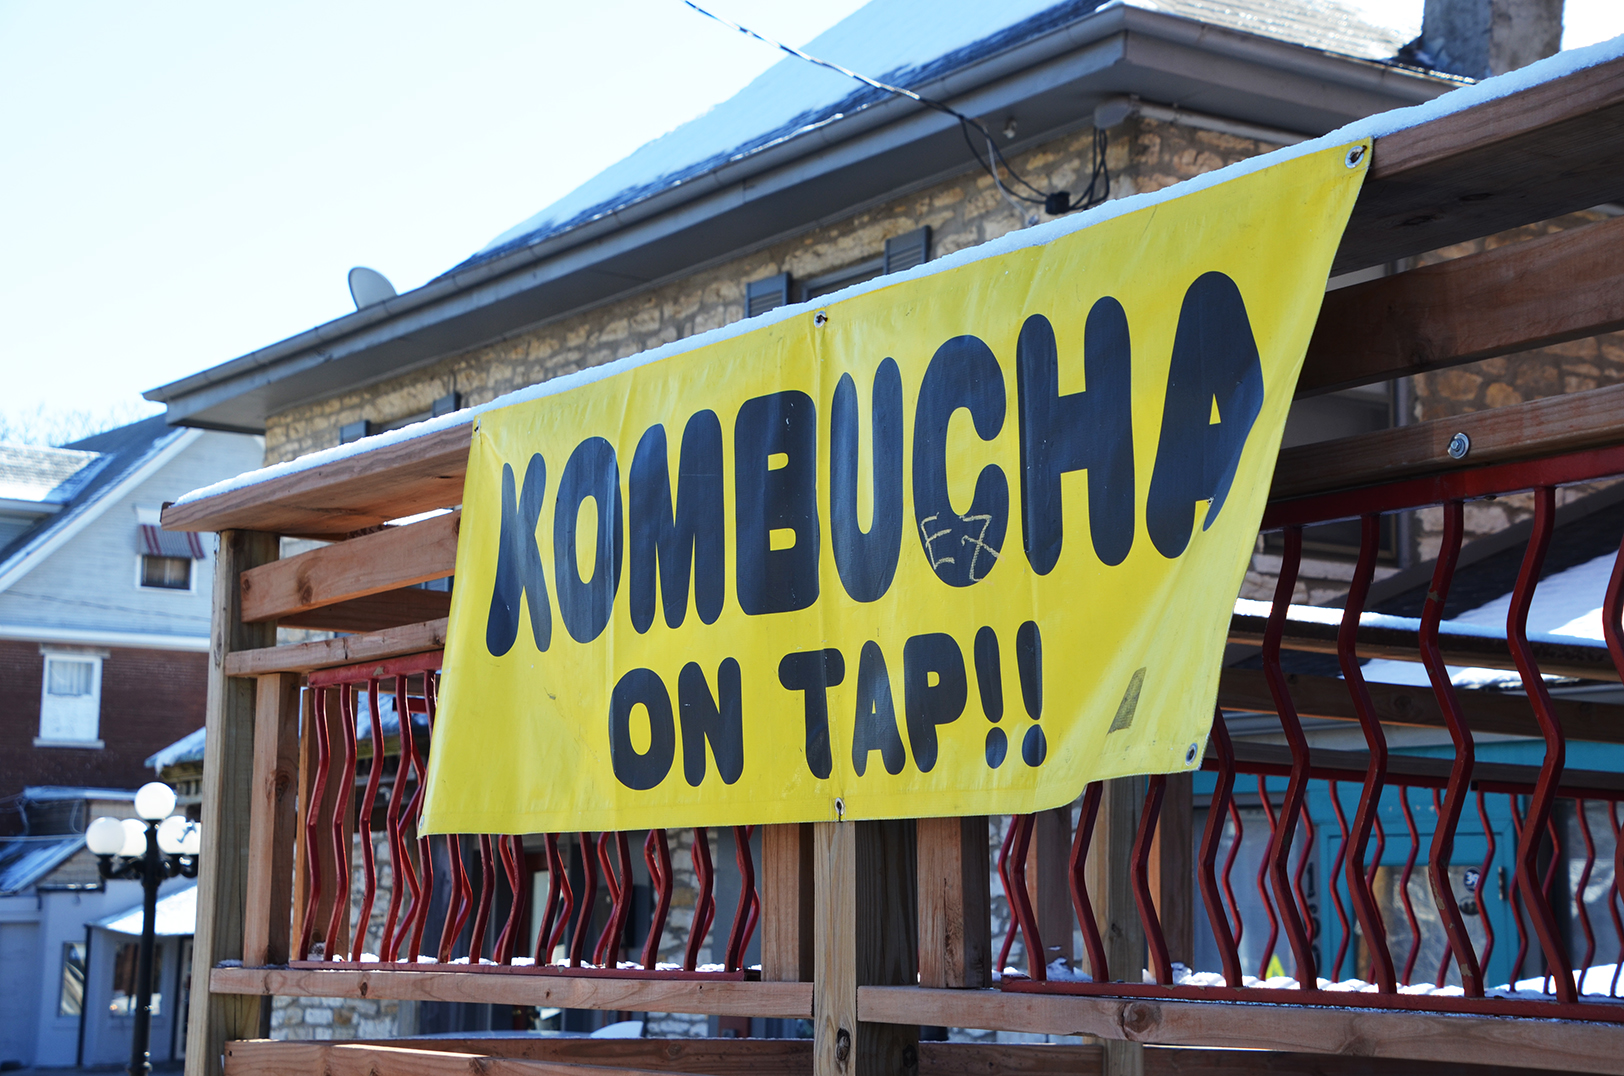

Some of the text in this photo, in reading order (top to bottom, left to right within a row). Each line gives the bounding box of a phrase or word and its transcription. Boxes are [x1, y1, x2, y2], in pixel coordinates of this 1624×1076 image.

[486, 271, 1264, 658] KOMBUCHA
[611, 620, 1048, 790] ON TAP!!
